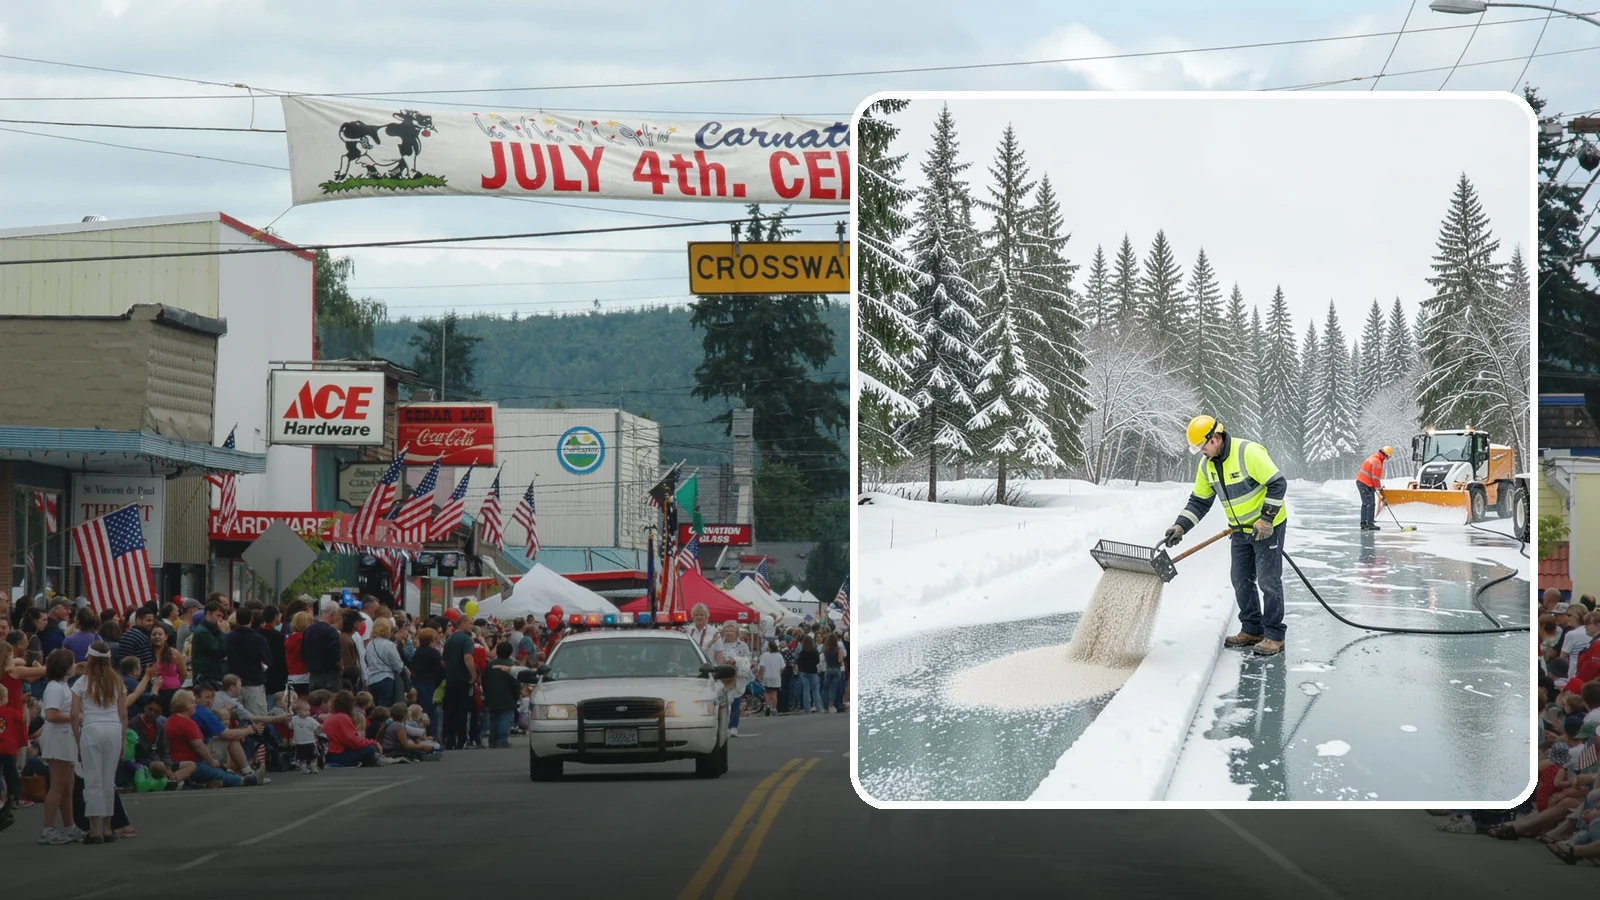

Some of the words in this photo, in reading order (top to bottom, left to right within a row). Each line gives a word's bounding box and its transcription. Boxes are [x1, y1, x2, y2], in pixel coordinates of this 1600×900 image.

[481, 141, 604, 192] JULY
[632, 150, 746, 197] 4th.
[697, 254, 850, 280] CROSSWA
[283, 380, 373, 420] ACE
[406, 409, 452, 421] CEDAR
[461, 409, 485, 421] LOG
[283, 421, 370, 436] Hardware
[416, 428, 476, 446] Coca-Cola
[353, 467, 386, 480] Simpl
[95, 485, 124, 495] Vincent
[126, 485, 135, 495] de
[137, 485, 155, 495] Paul
[688, 526, 741, 535] CRNATION
[699, 535, 730, 543] GLASS
